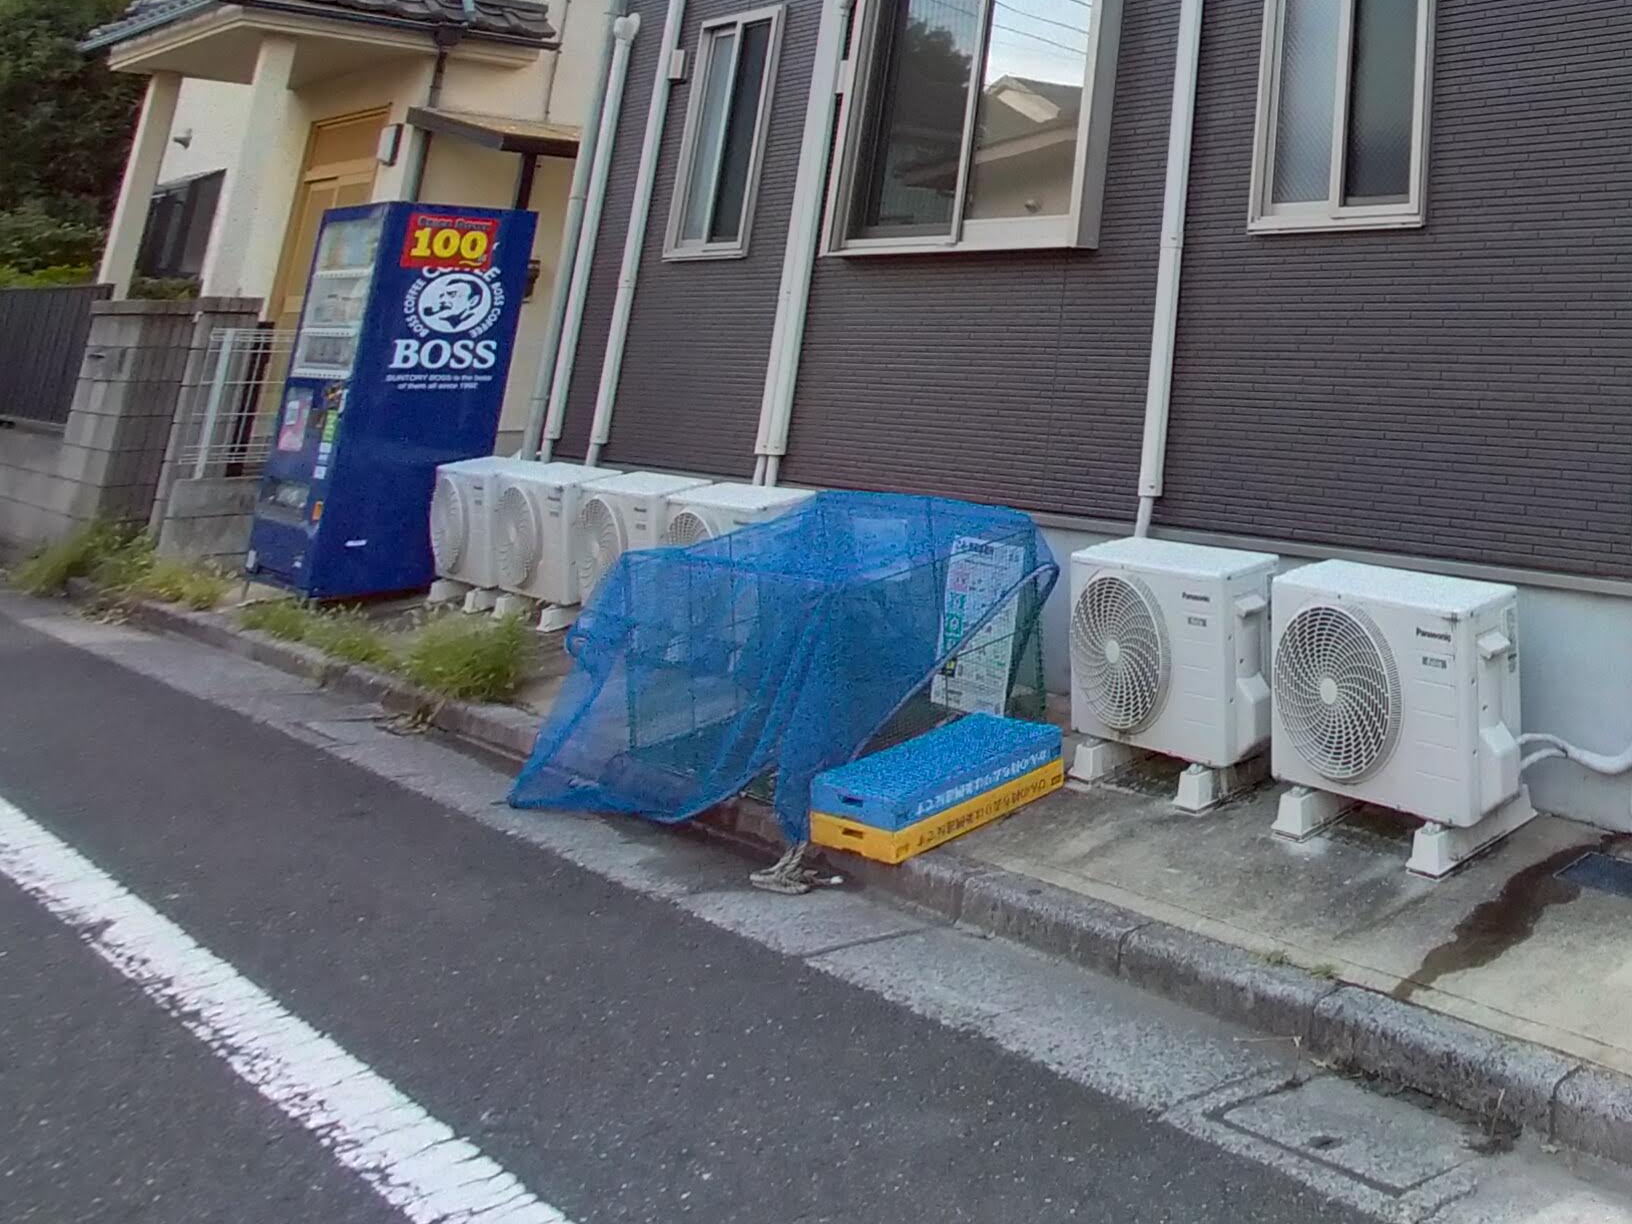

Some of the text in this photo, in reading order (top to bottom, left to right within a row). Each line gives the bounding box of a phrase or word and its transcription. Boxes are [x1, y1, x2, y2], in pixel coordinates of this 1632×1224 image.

[410, 227, 488, 259] 100
[403, 278, 430, 337] BOSS COFFEE
[491, 282, 505, 306] BOSS
[388, 338, 498, 369] BOSS
[1416, 627, 1451, 642] Panasonic
